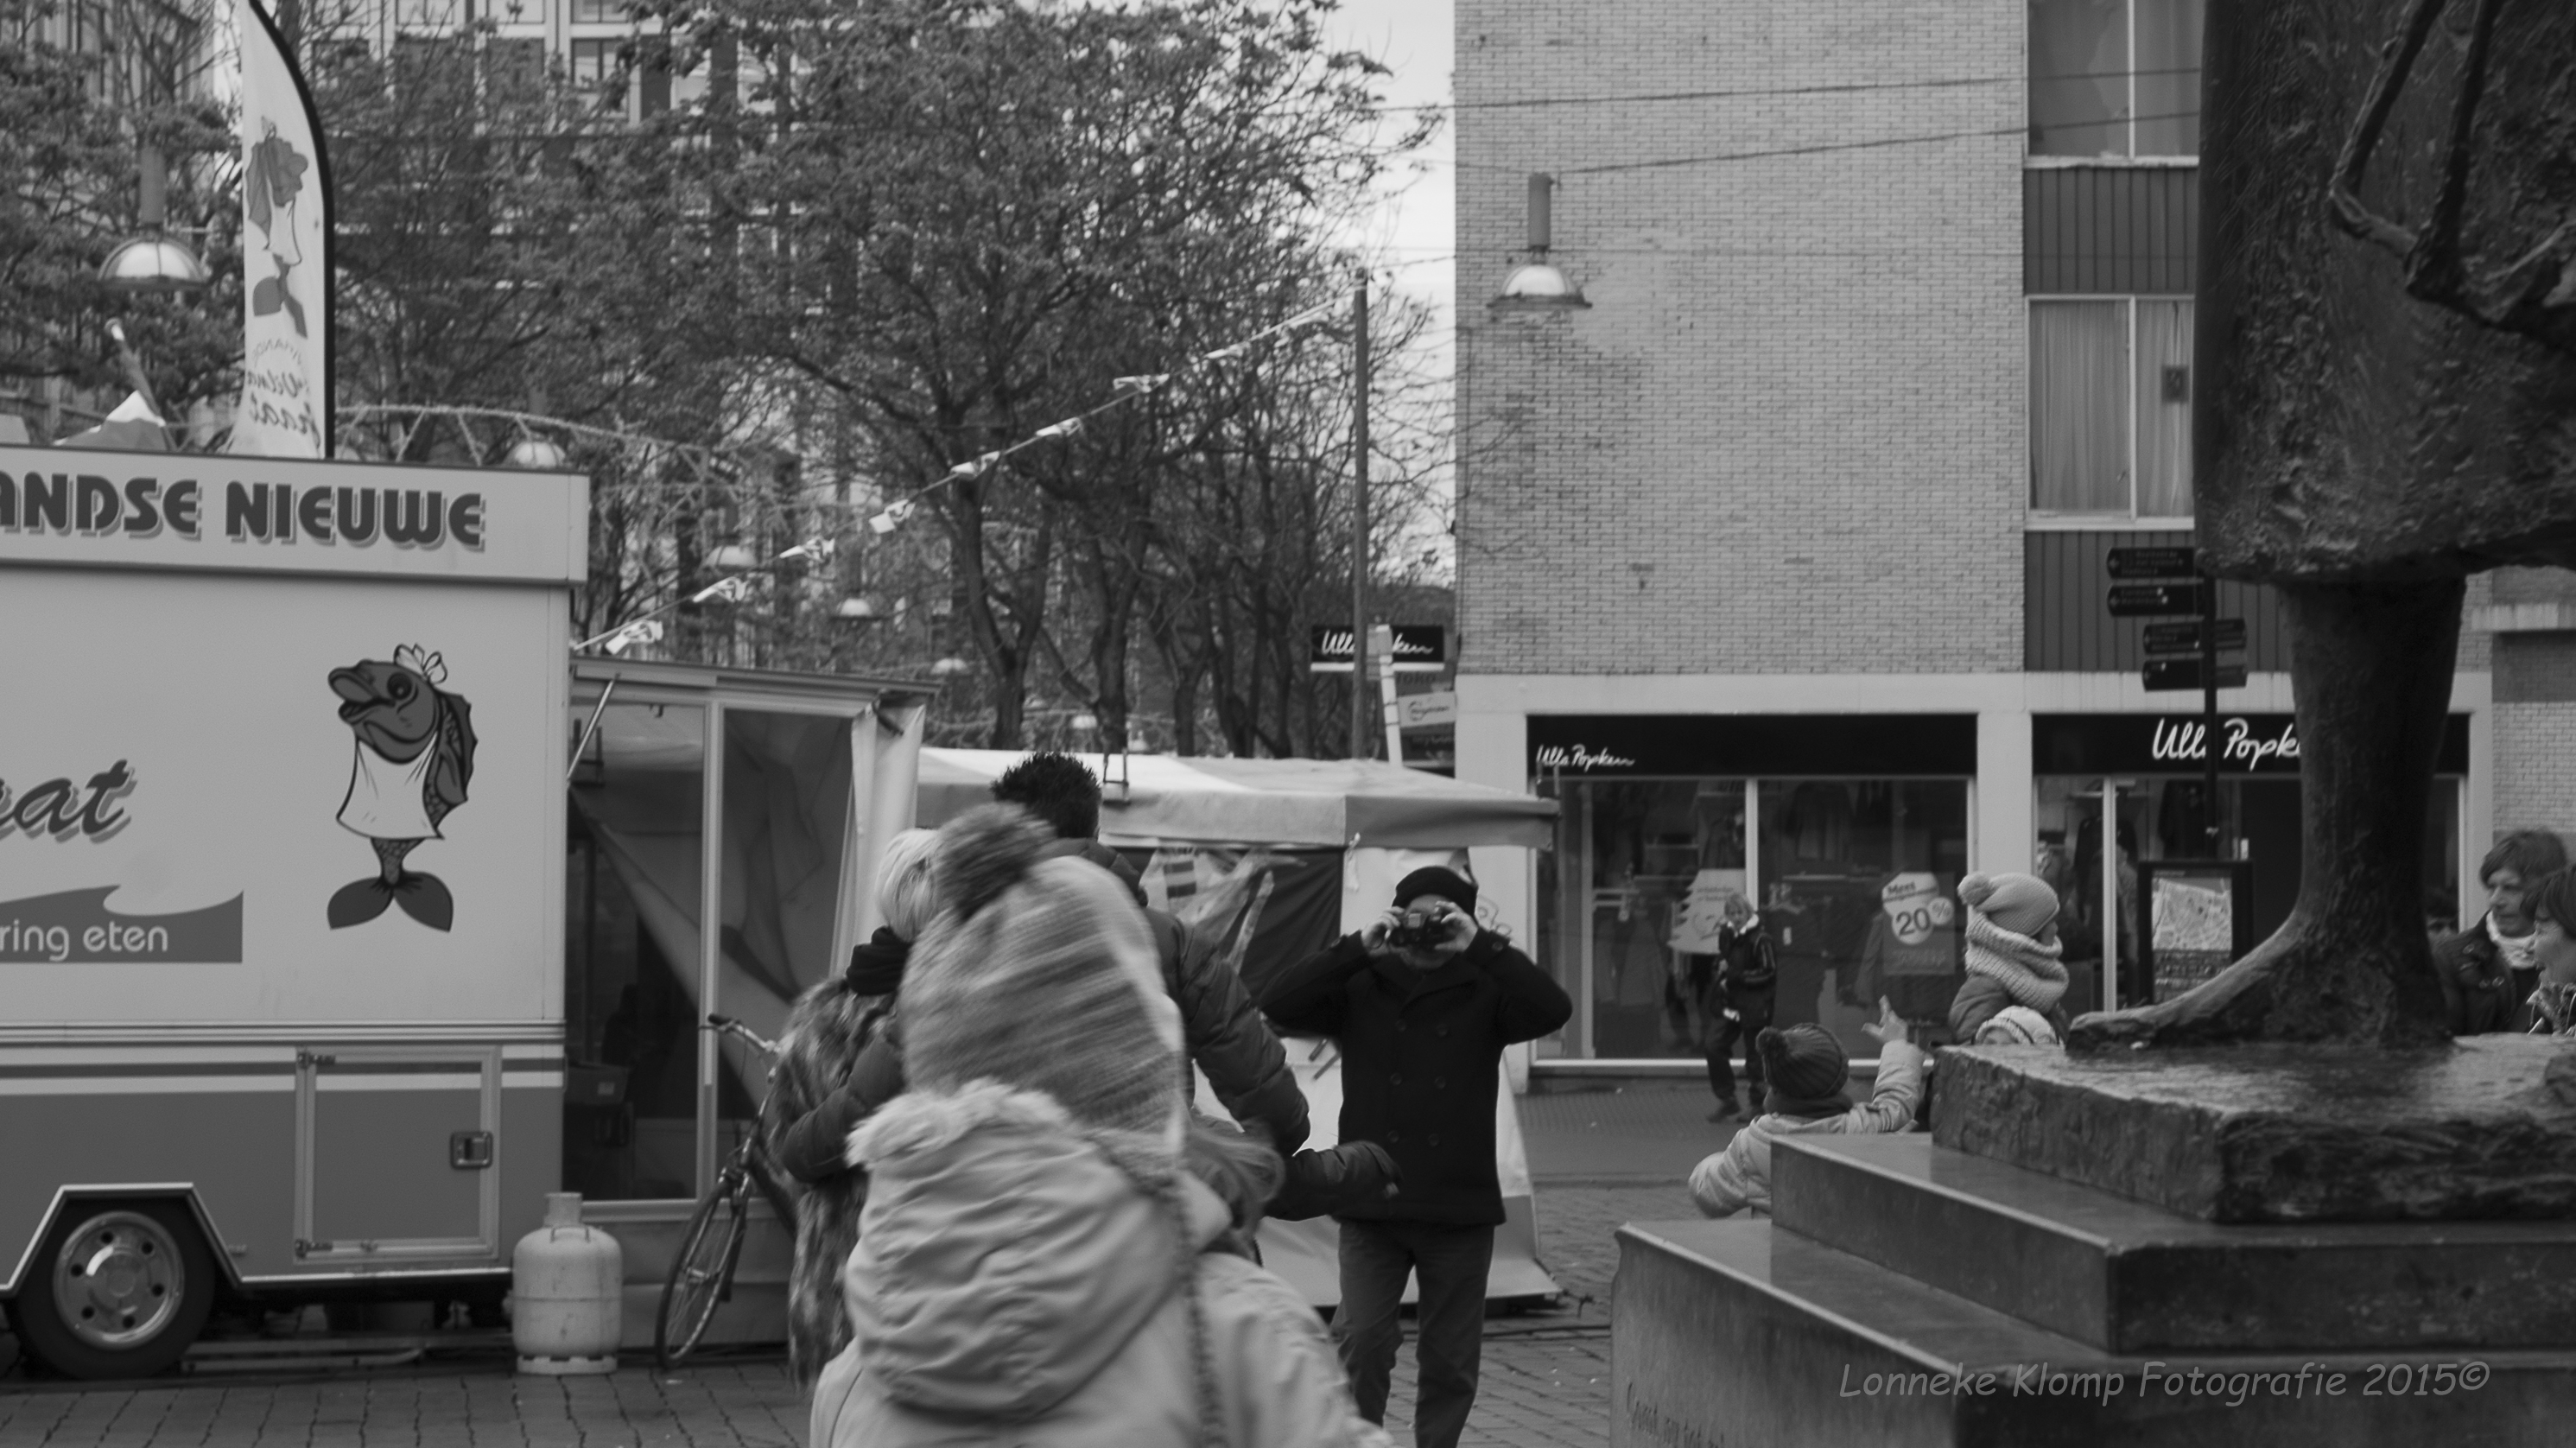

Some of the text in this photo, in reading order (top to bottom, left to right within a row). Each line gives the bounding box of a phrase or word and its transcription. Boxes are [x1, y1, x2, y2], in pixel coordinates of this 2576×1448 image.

[225, 481, 485, 552] NIEUWE
[1321, 628, 1355, 655] Ull
[1536, 744, 1635, 773] Ulla Popken
[2152, 717, 2300, 772] Ull Popke
[0, 759, 136, 843] at
[83, 920, 168, 952] eten
